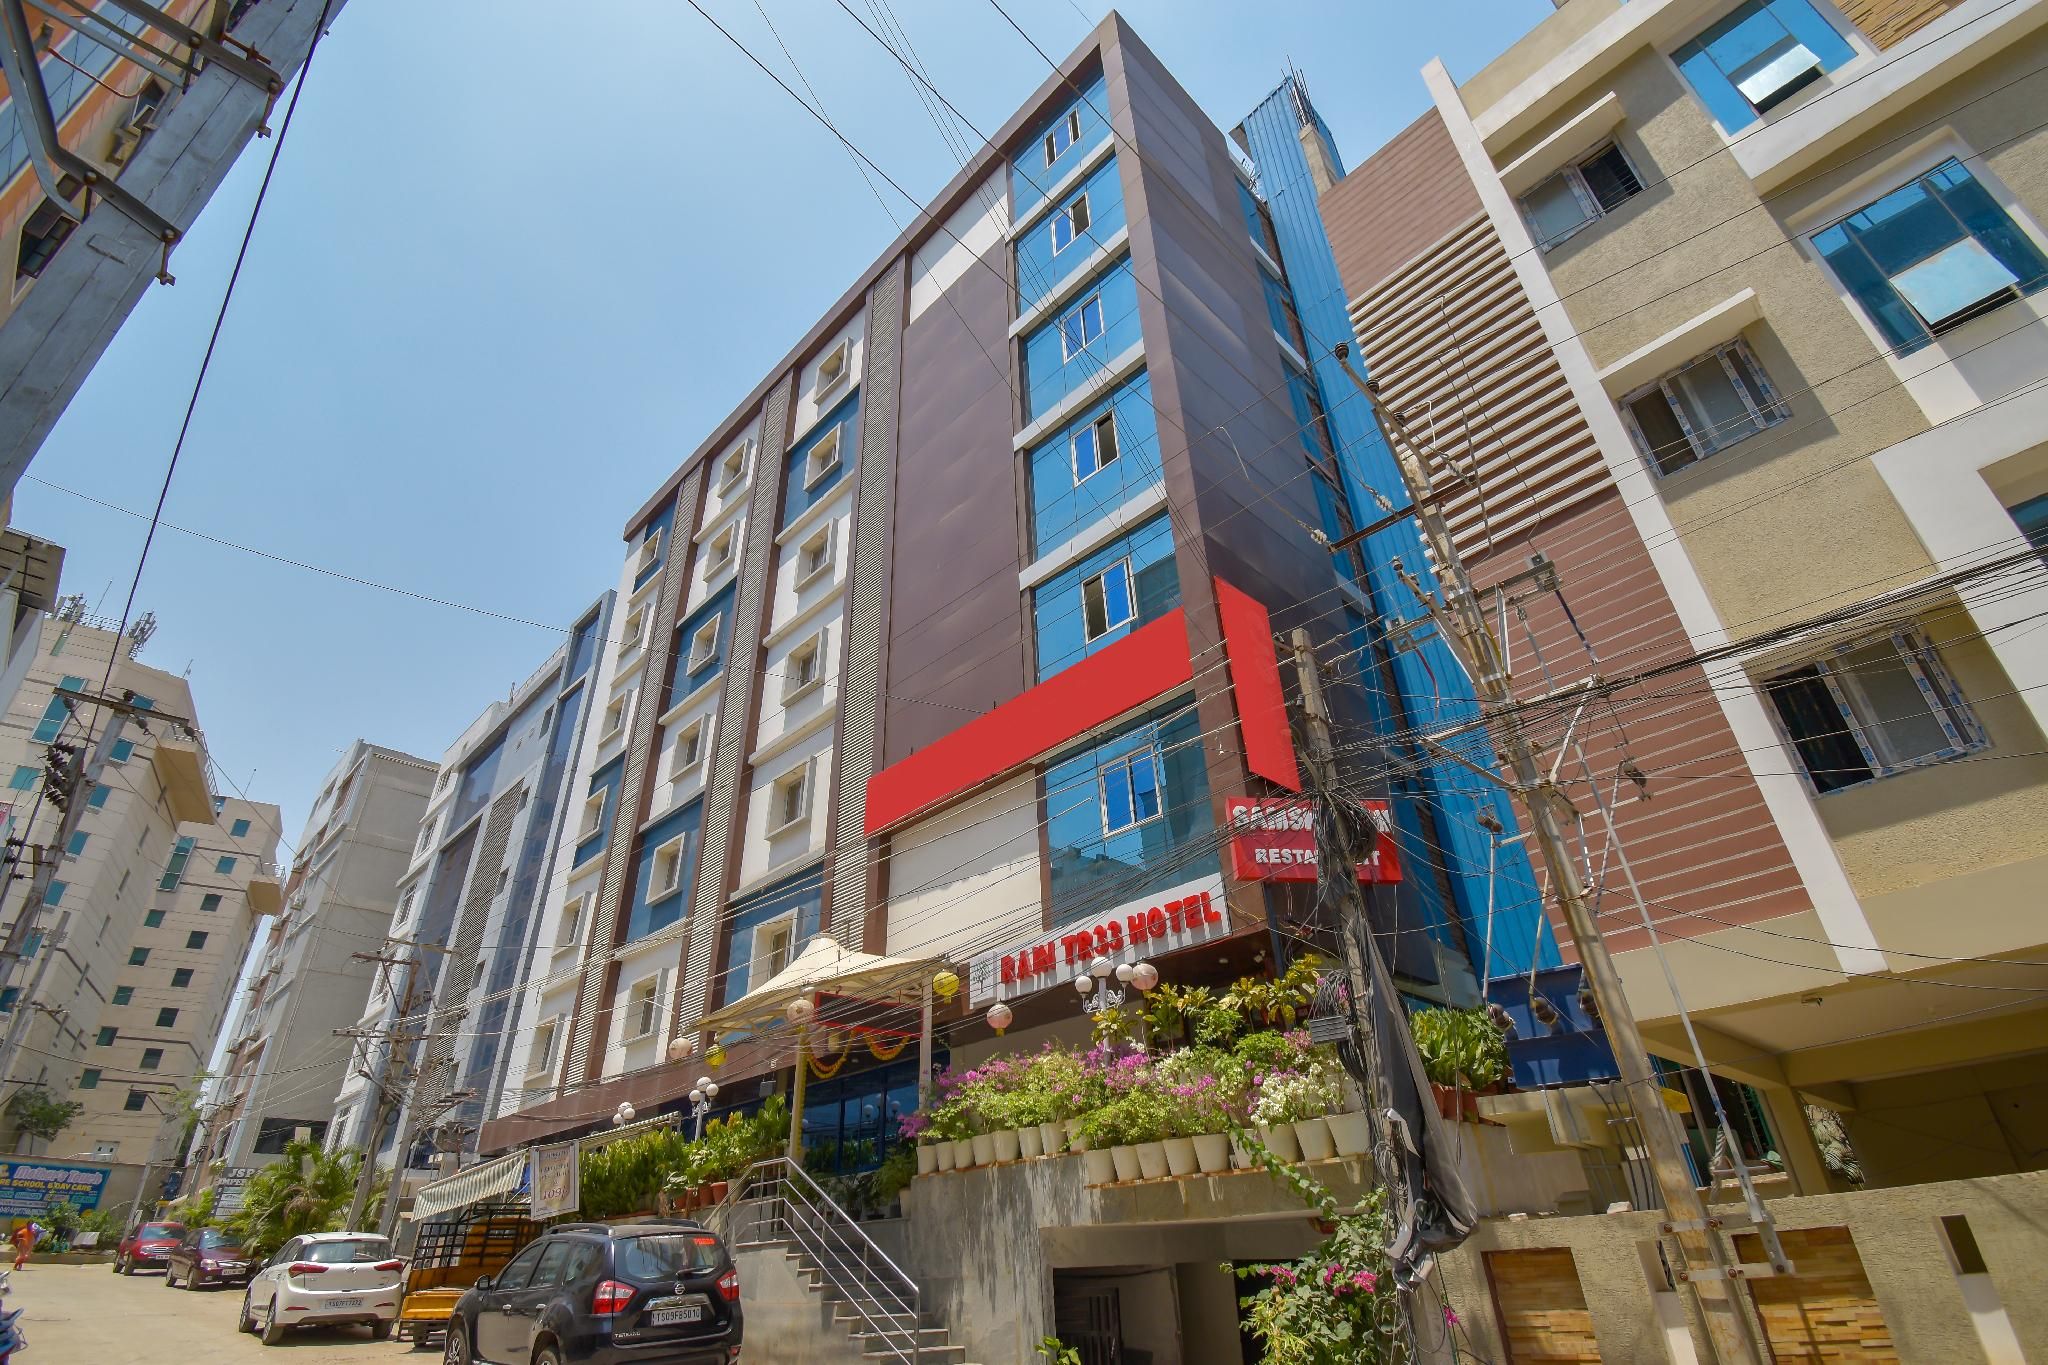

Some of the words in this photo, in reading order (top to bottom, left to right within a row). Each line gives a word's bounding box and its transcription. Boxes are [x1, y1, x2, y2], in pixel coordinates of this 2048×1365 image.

[1000, 940, 1057, 984] RAIN
[1061, 920, 1125, 965] TR33
[1127, 891, 1222, 945] HOTEL
[12, 1179, 46, 1189] SCHOOL
